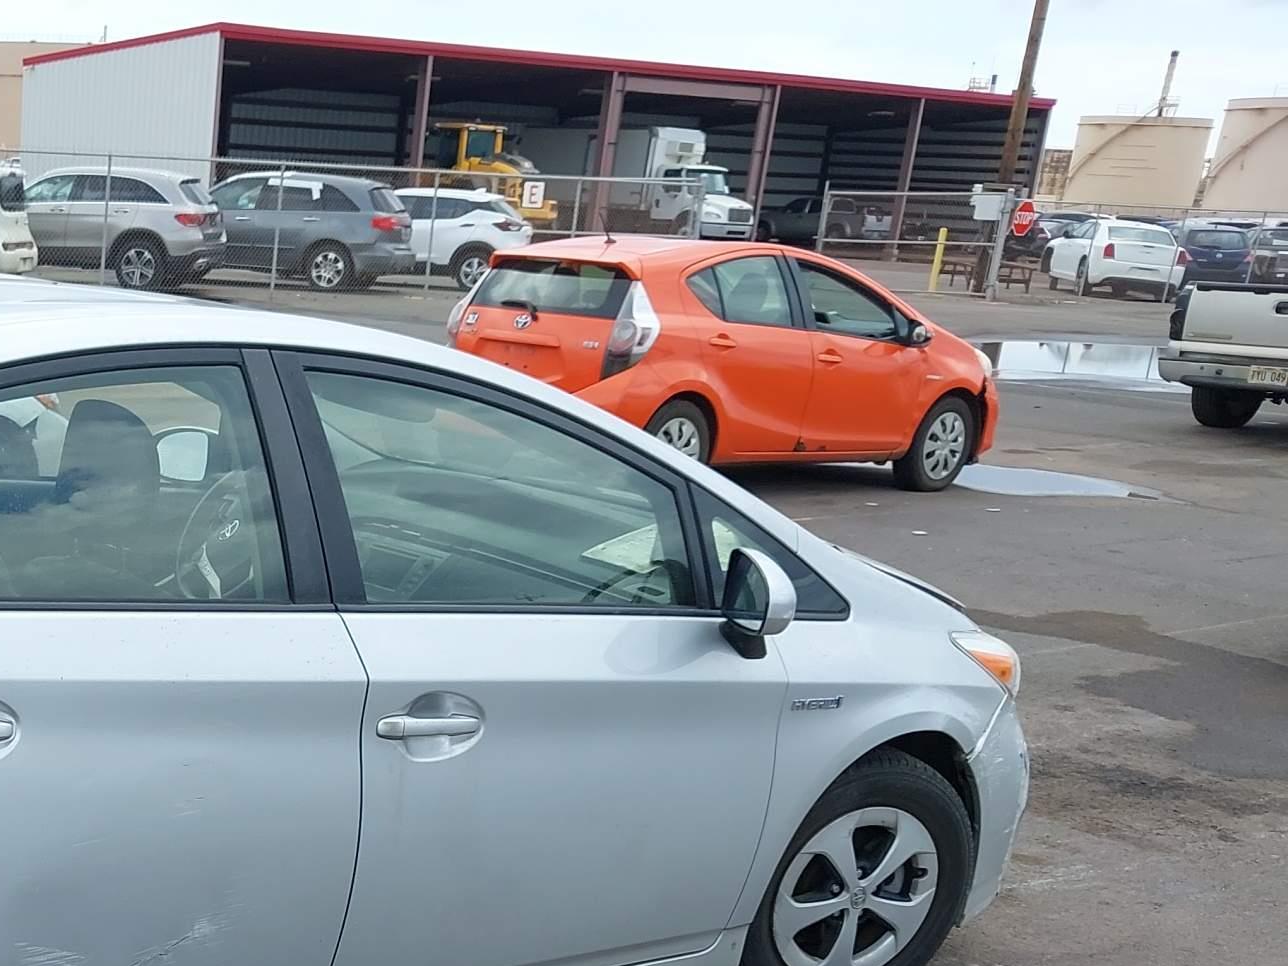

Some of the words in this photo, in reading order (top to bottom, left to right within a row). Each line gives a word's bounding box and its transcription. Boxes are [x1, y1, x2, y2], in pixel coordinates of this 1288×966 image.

[528, 185, 539, 204] E
[1014, 211, 1033, 225] STOP
[1270, 371, 1287, 383] 049
